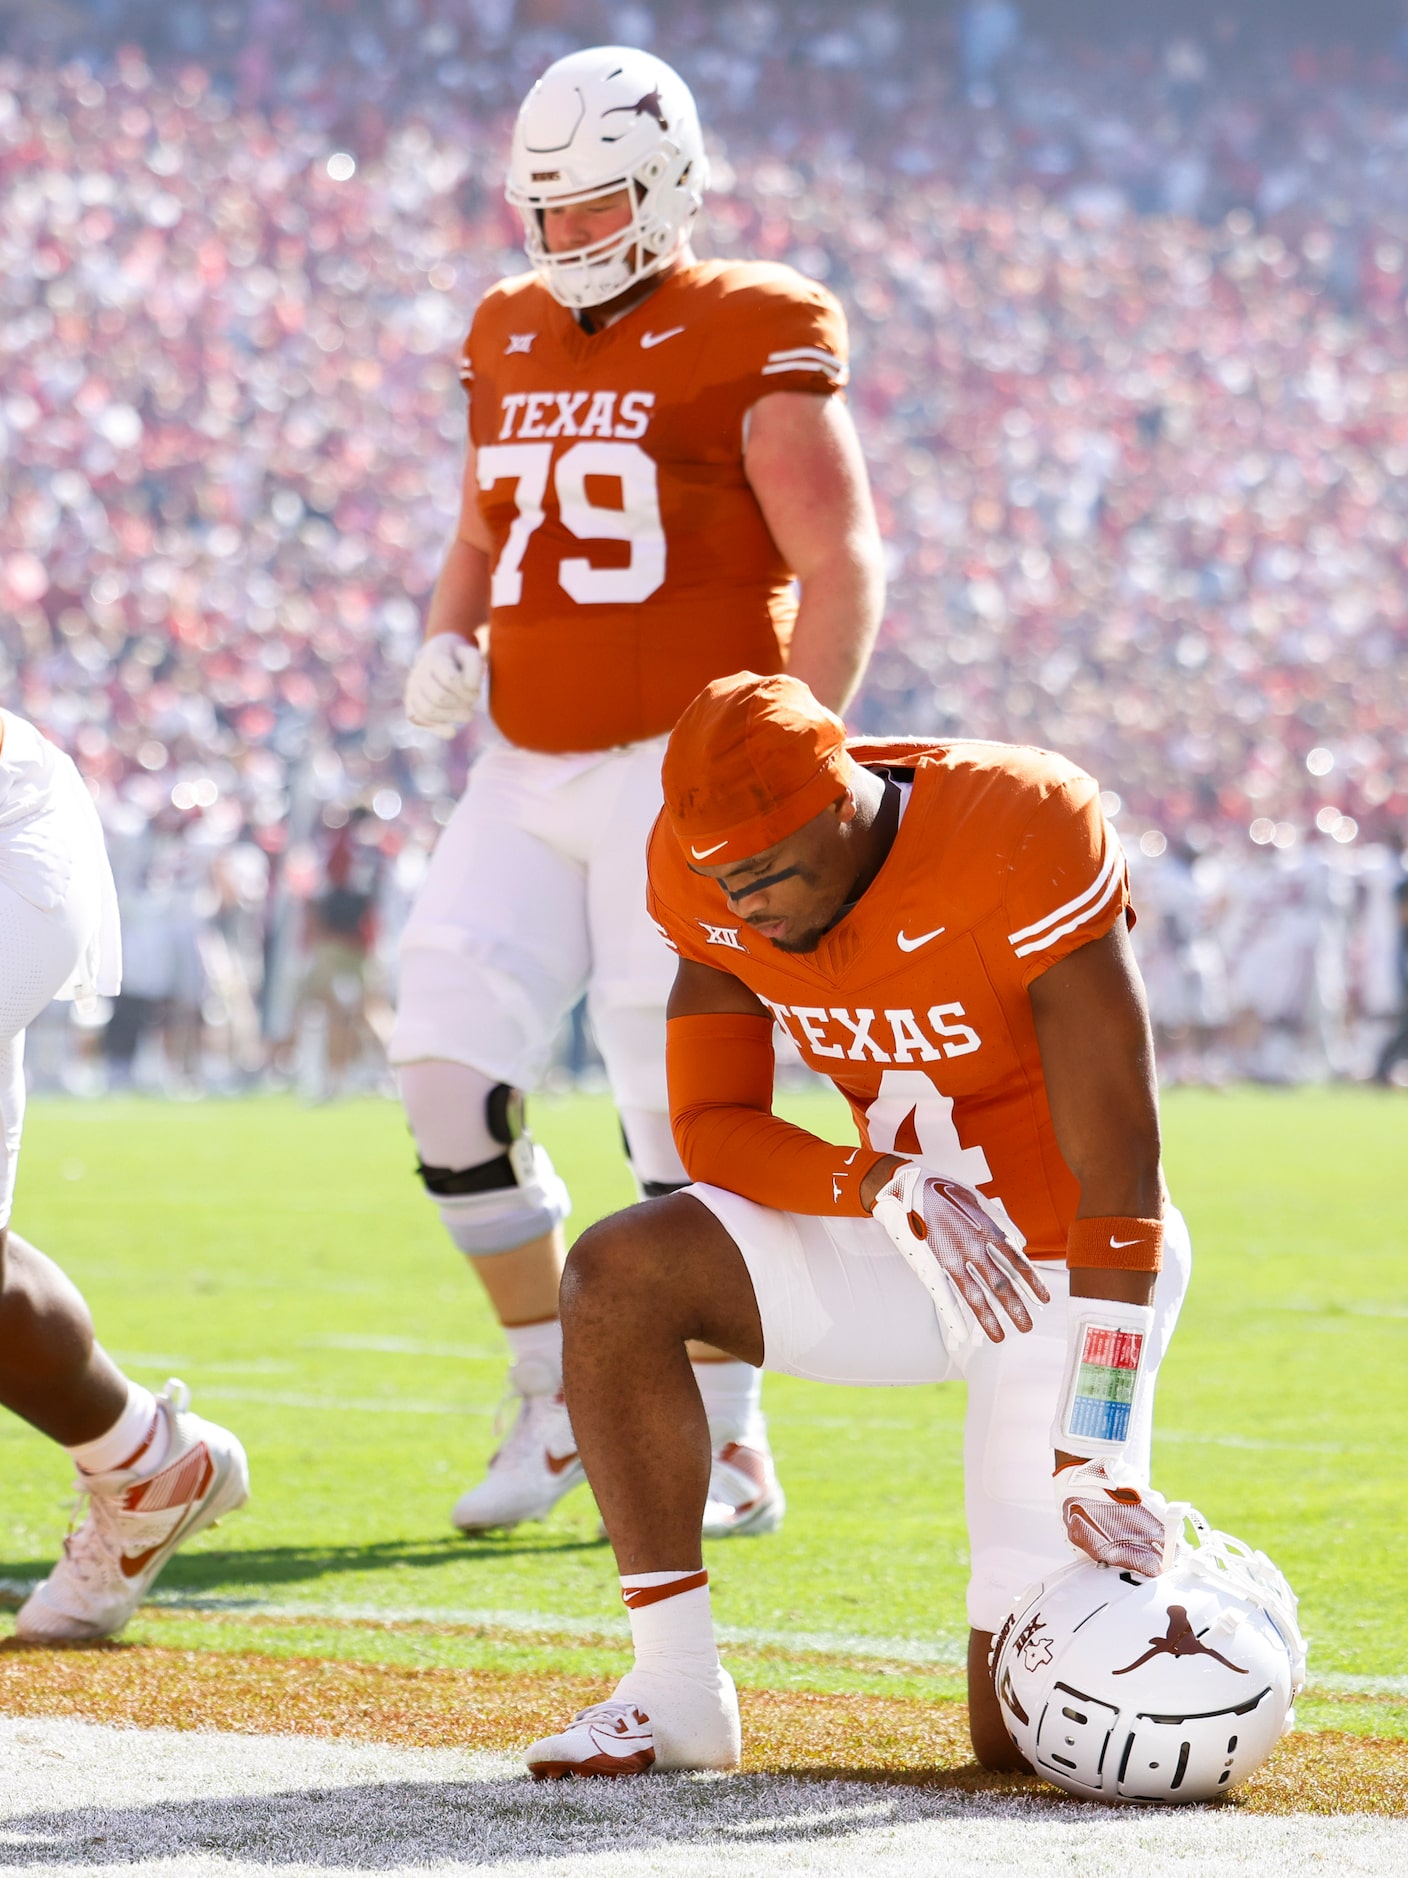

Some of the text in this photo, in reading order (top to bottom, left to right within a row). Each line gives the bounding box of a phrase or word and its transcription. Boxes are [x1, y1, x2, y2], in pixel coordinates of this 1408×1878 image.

[499, 392, 655, 440] TEXAS
[477, 442, 667, 607] 79
[698, 921, 746, 952] XII
[756, 992, 982, 1063] TEXAS
[865, 1070, 1020, 1240] 4
[1012, 1612, 1047, 1658] XII
